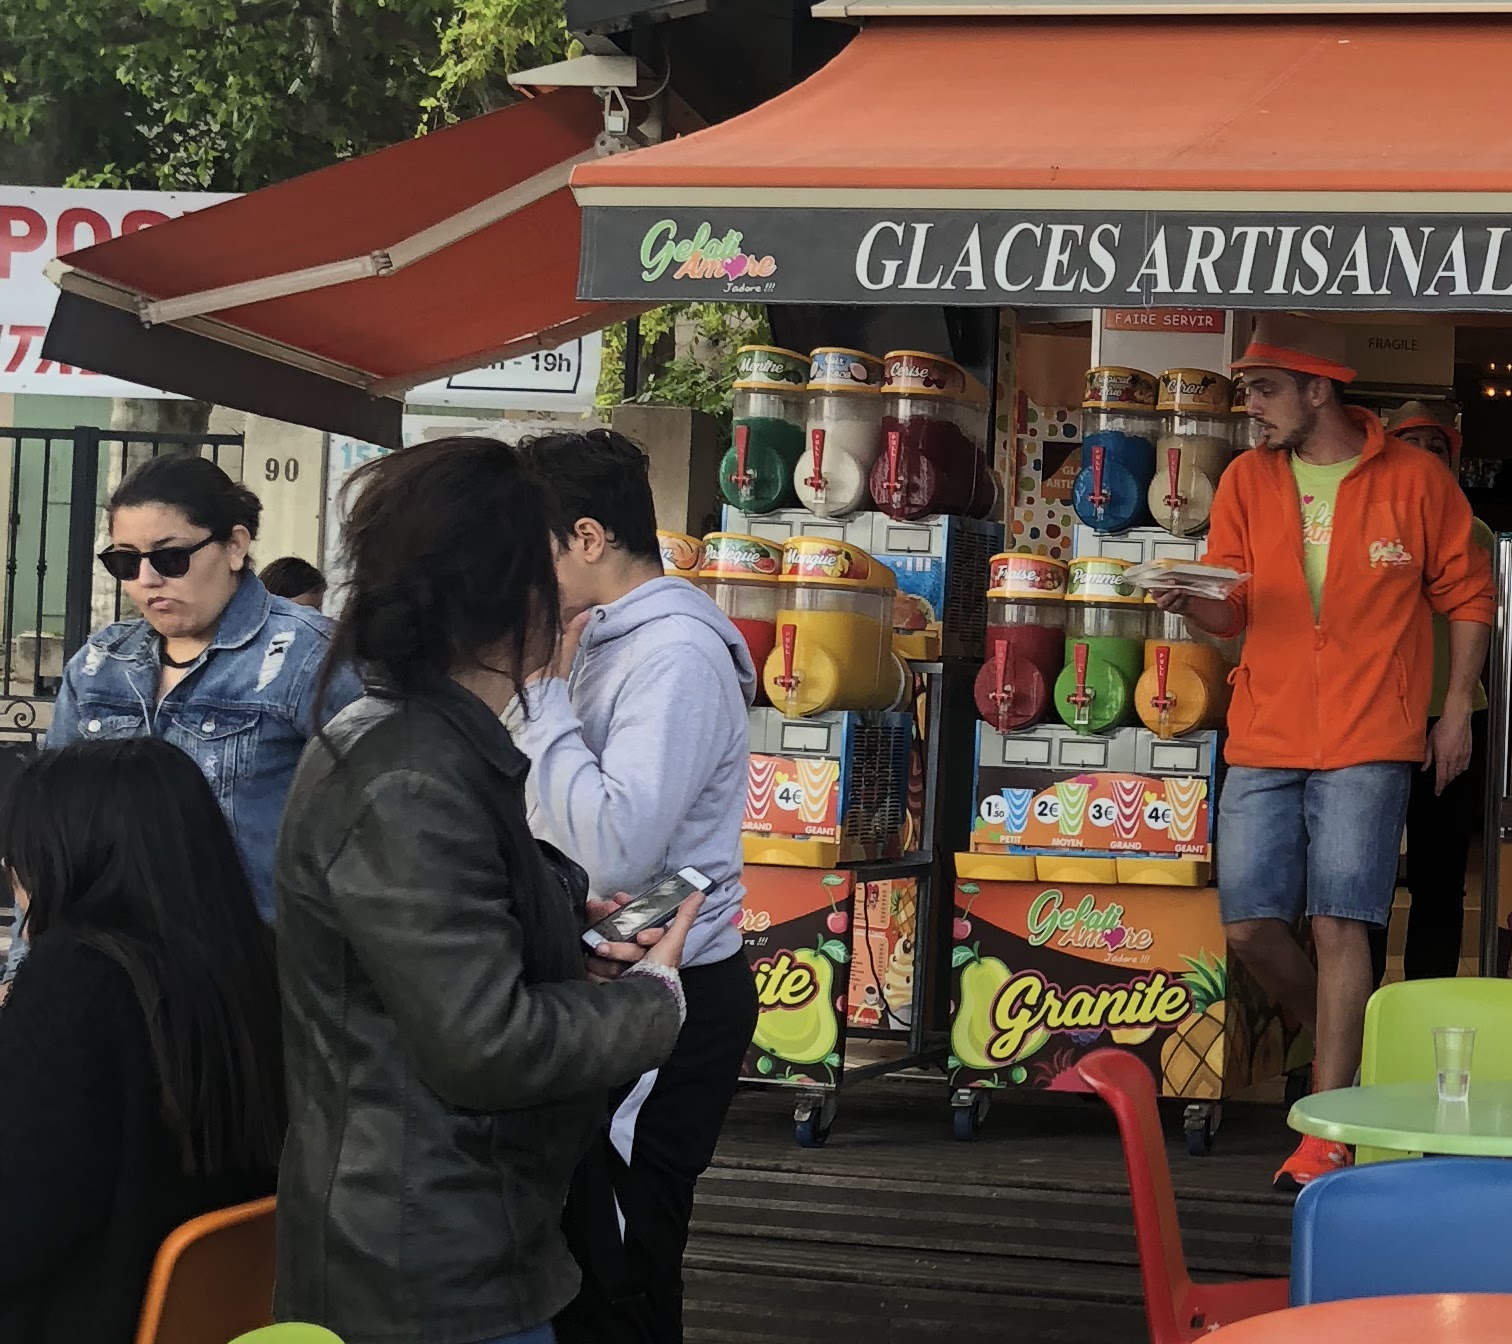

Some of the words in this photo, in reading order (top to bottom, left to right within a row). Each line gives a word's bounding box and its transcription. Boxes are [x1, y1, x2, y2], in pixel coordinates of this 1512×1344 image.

[640, 219, 744, 282] Gelati
[855, 221, 1121, 293] GLACES
[1115, 314, 1157, 326] FAIRE
[1163, 314, 1214, 327] SERVIR
[1368, 337, 1418, 351] FRAGILE
[531, 353, 571, 373] 19h
[738, 358, 785, 374] Menthe
[890, 362, 929, 378] Cerise
[265, 457, 299, 482] 90
[1073, 568, 1124, 585] Pomme
[1110, 840, 1142, 850] GRAND
[1027, 888, 1123, 946] Gelati
[990, 973, 1190, 1060] Granite
